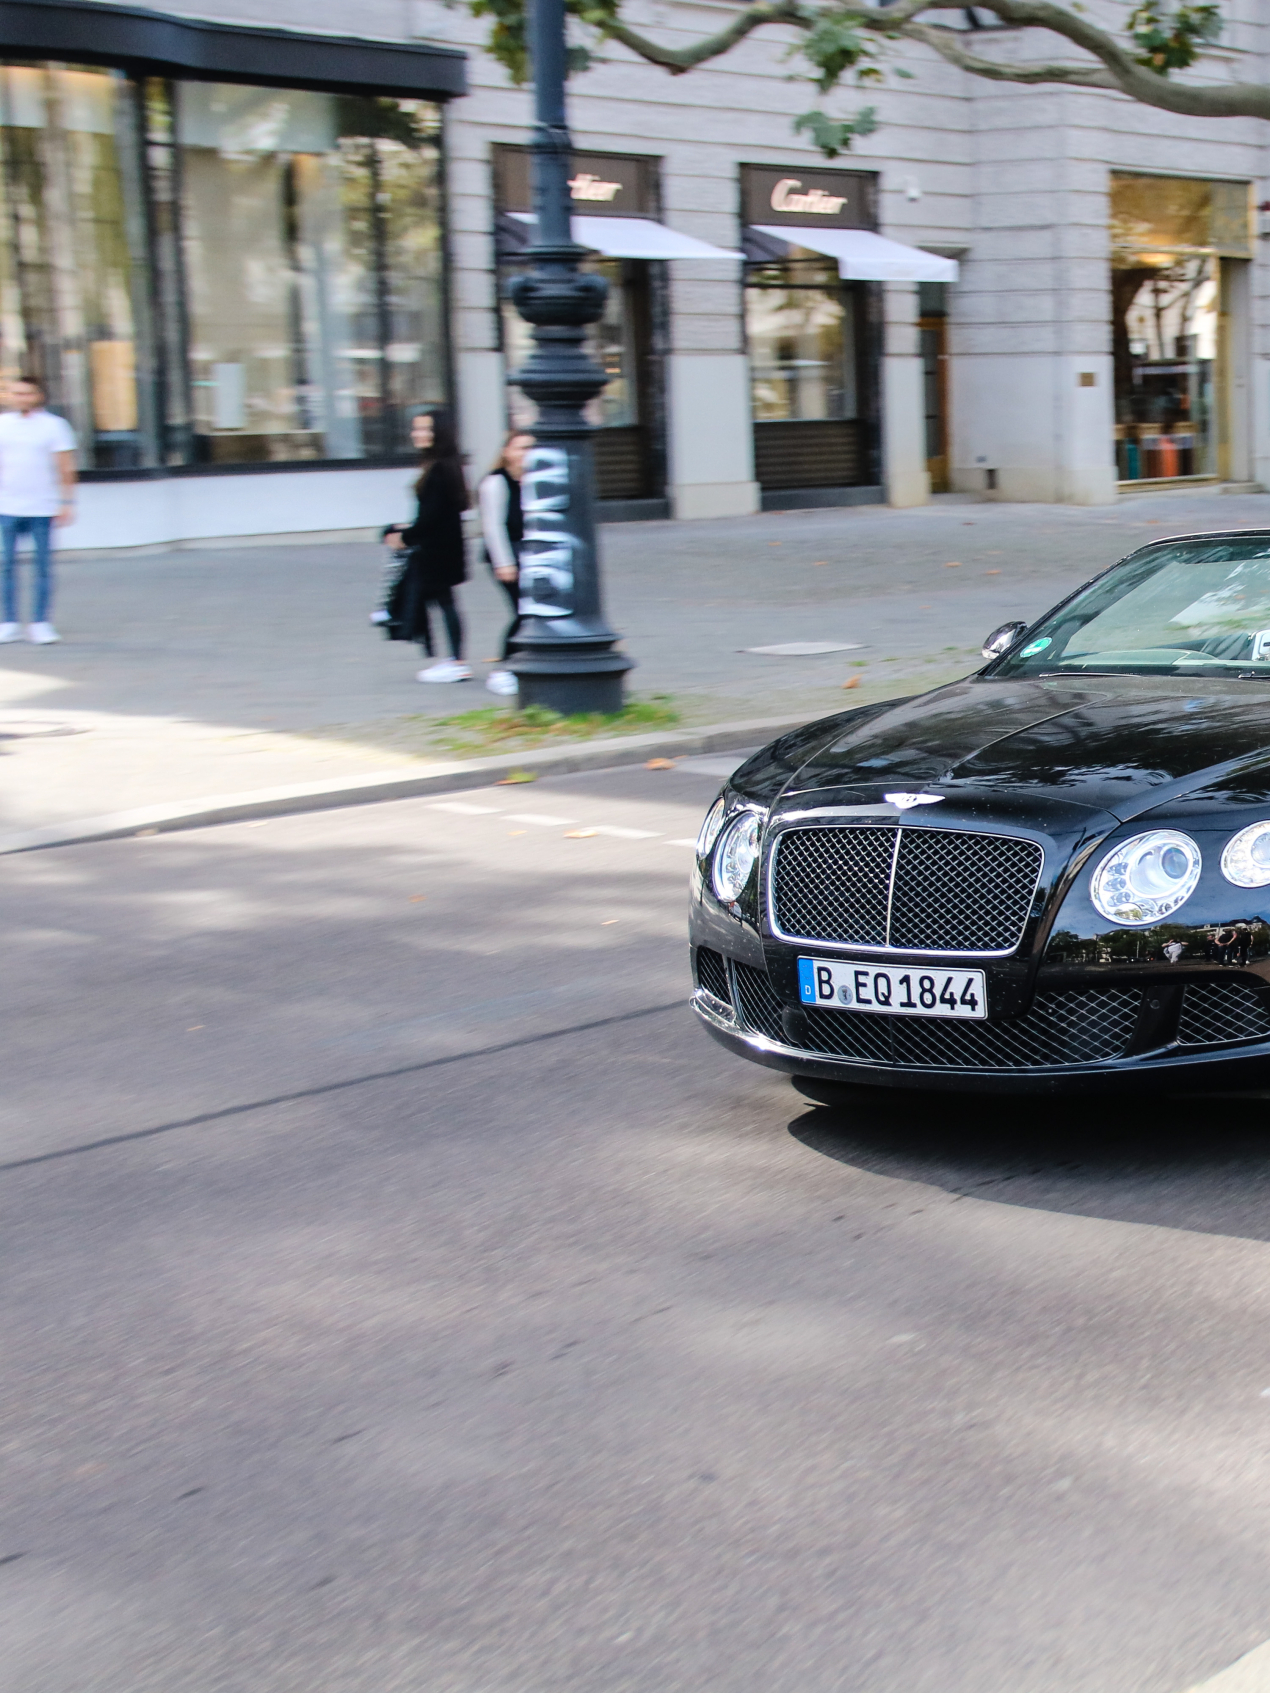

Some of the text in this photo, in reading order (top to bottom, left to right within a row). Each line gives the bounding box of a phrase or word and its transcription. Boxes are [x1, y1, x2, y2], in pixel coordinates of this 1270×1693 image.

[770, 178, 848, 215] Cartier
[804, 965, 979, 1012] D B EQ 1844
